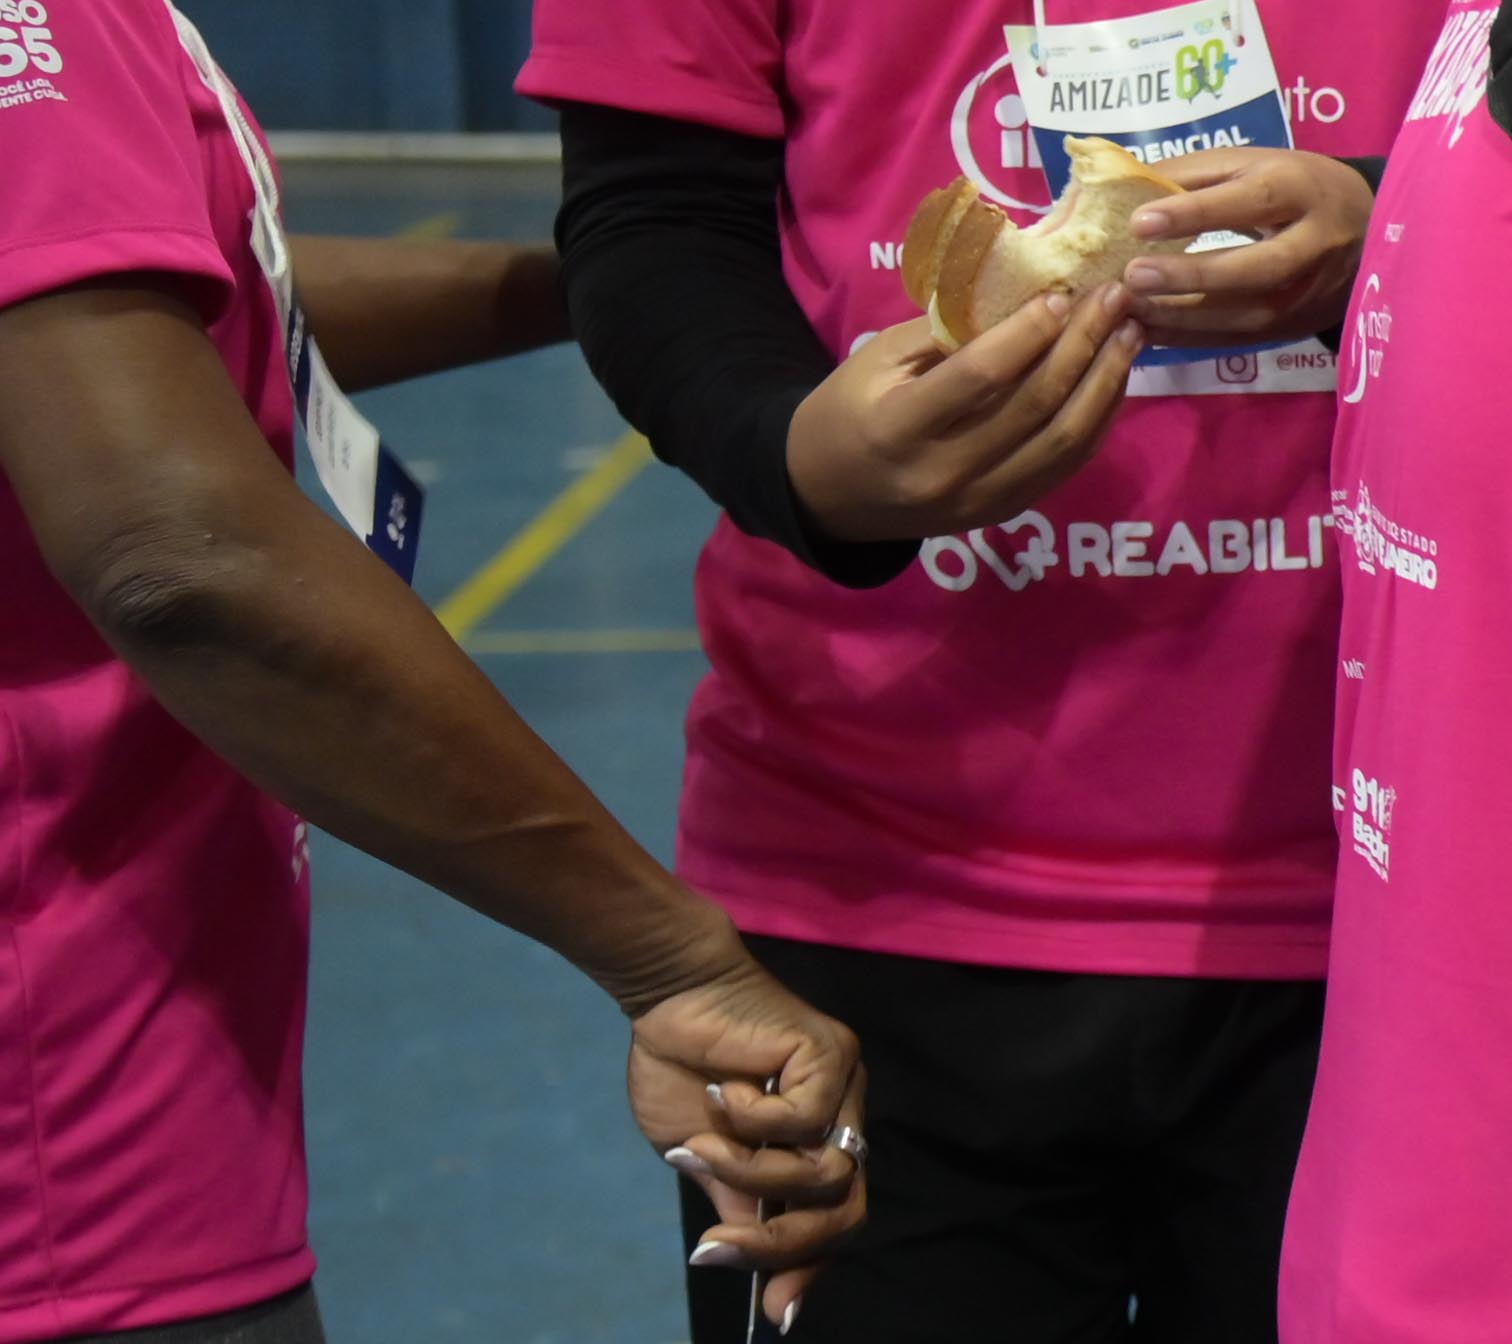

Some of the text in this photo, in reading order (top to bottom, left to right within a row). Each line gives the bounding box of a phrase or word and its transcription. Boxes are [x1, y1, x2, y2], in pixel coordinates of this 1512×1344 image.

[1050, 37, 1238, 113] AMIZADE 60+
[0, 93, 33, 109] ENTE
